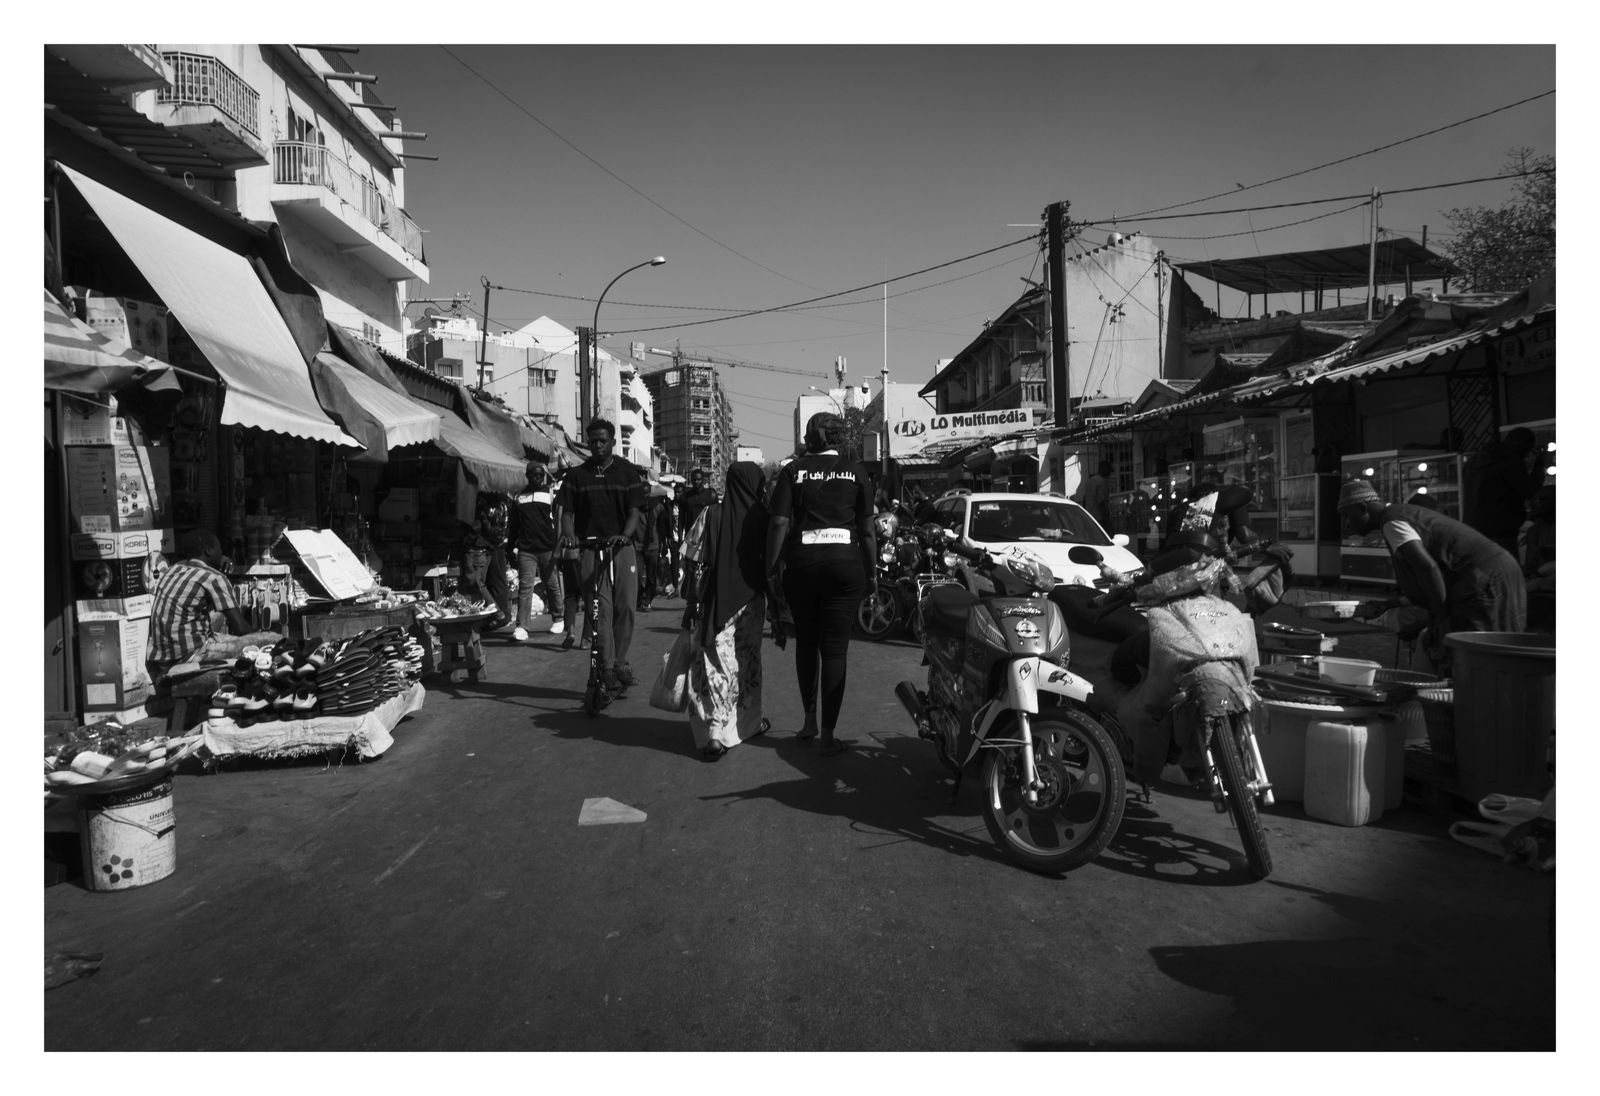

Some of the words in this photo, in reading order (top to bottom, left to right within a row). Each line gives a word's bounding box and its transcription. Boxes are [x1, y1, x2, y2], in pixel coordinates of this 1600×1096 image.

[930, 418, 949, 430] LO
[952, 410, 1027, 428] Multimédia
[78, 543, 113, 551] KOREQ
[124, 540, 147, 548] KOREQ
